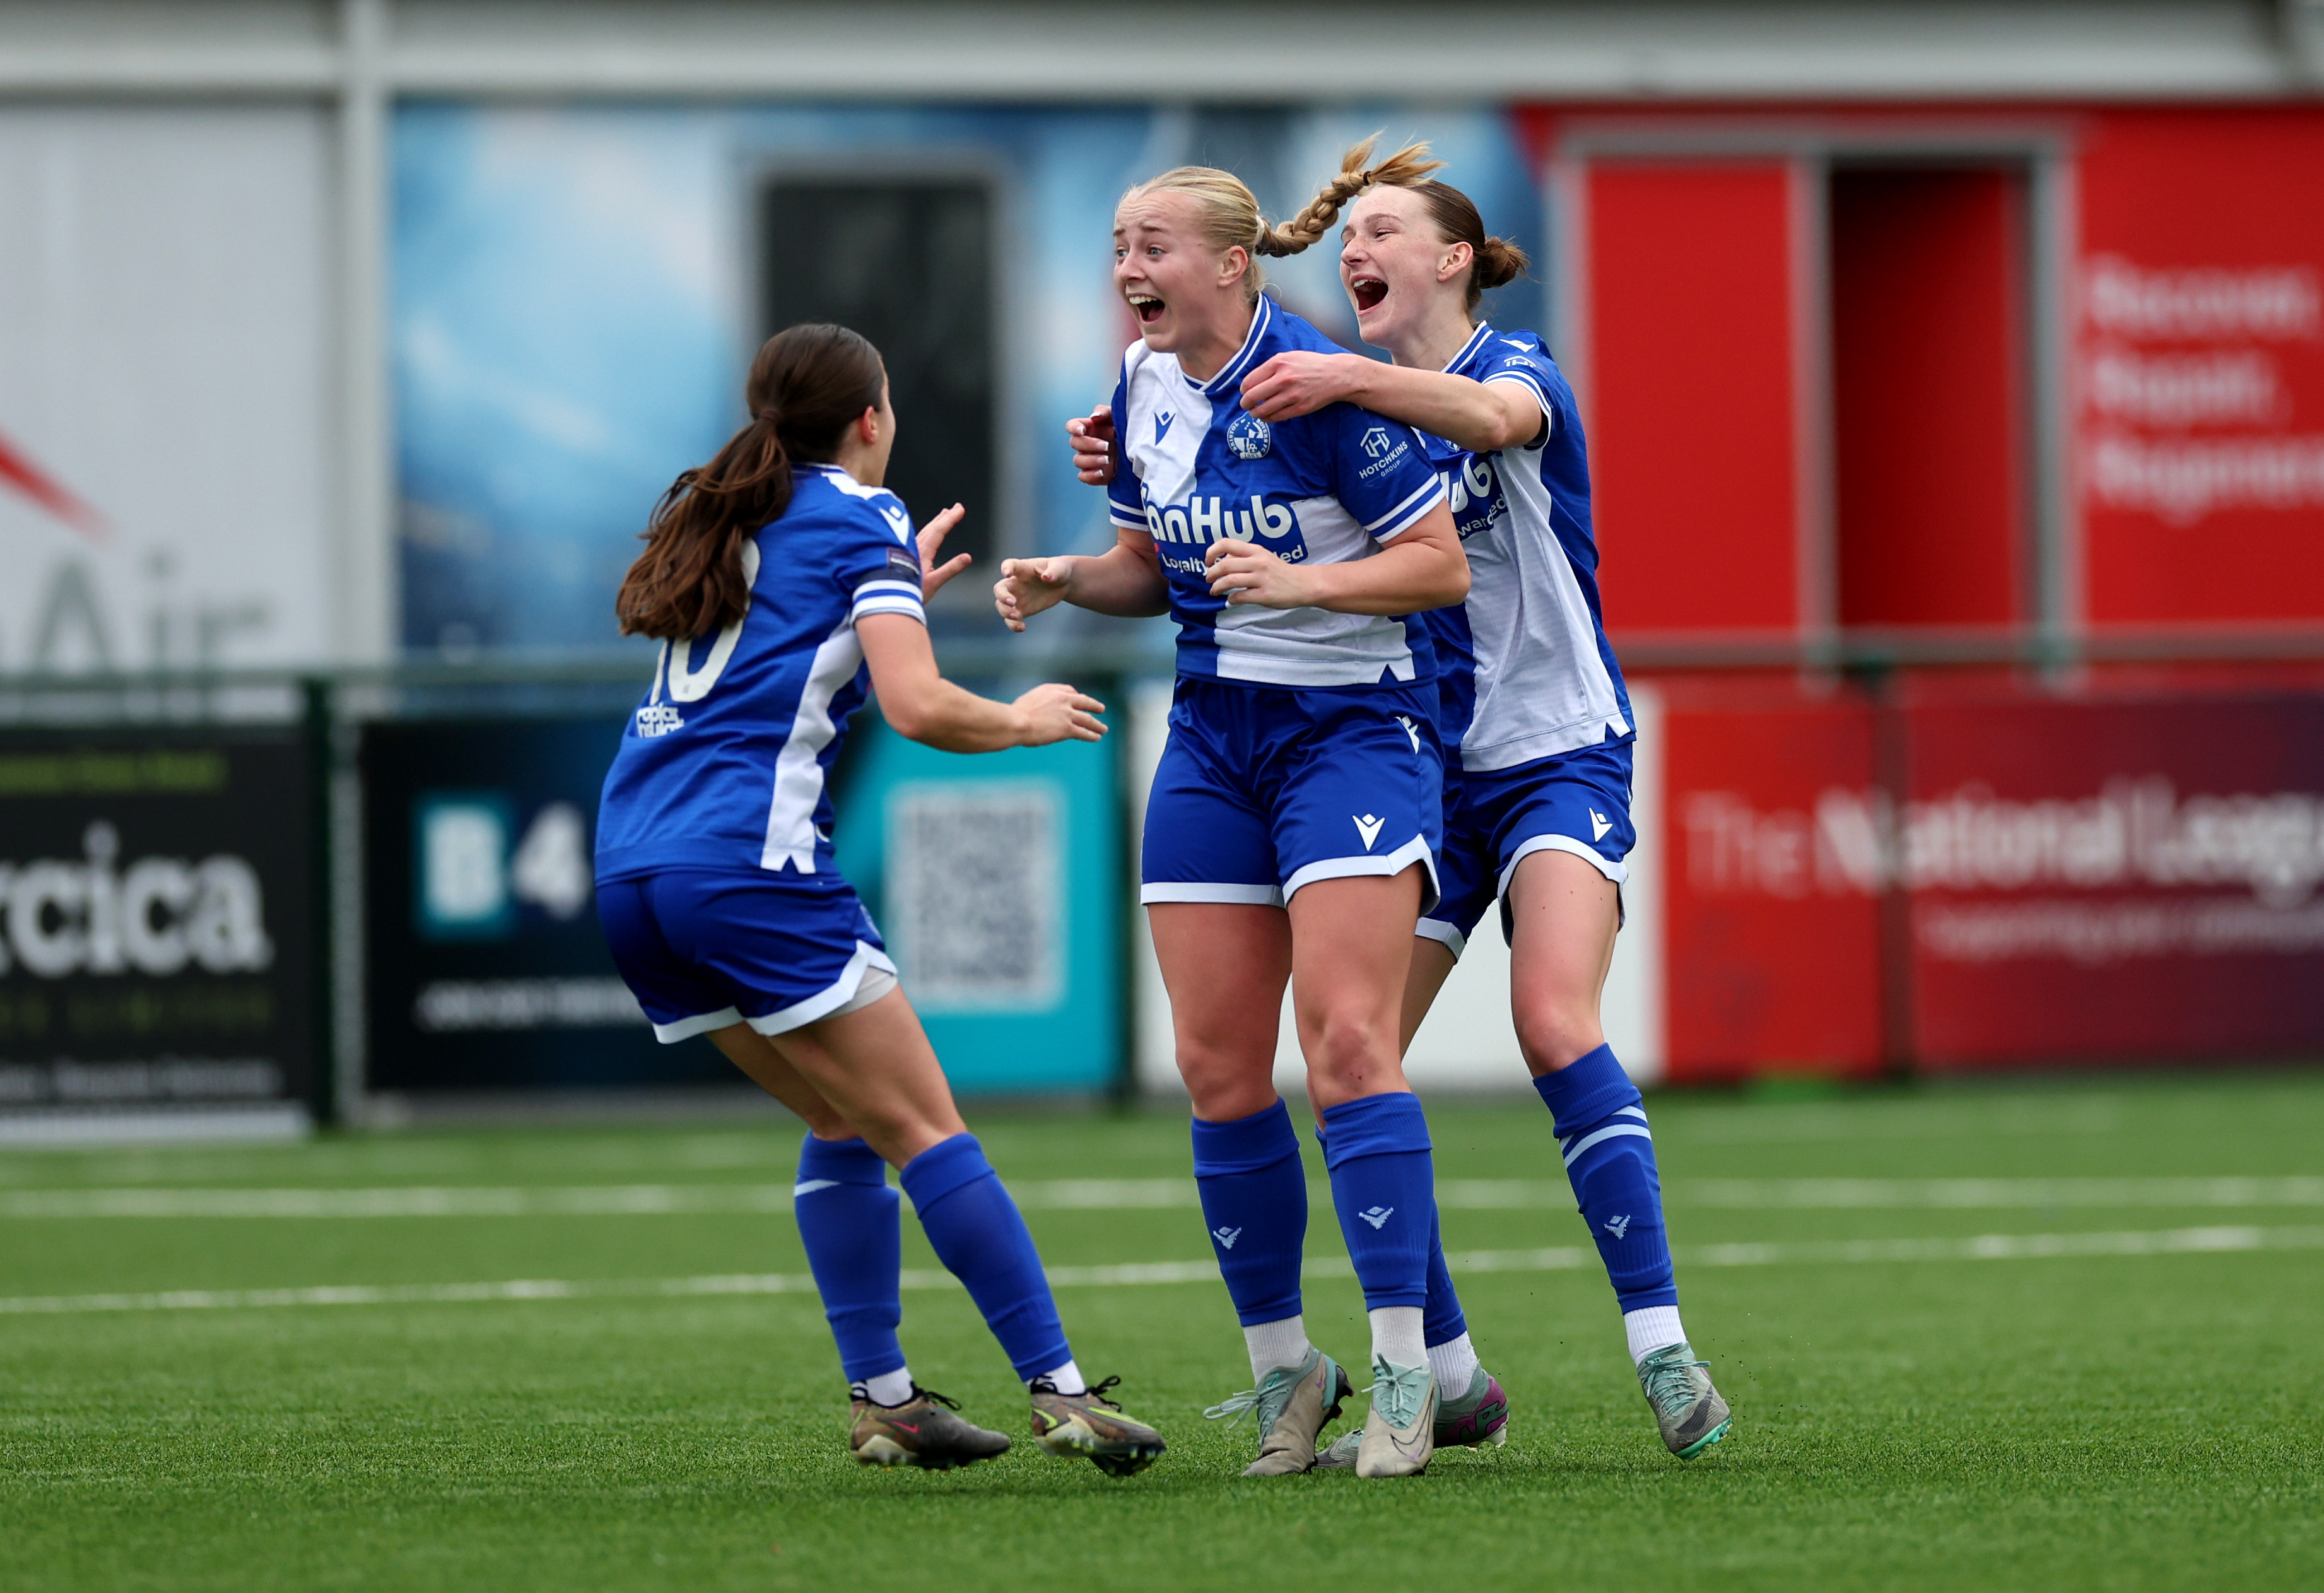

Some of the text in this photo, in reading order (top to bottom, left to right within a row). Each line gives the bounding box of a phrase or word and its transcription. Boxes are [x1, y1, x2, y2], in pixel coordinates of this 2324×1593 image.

[1229, 423, 1239, 451] BRISTOL
[1256, 418, 1268, 452] ROVERS FC
[1359, 441, 1408, 479] HOTCHKINS
[1380, 460, 1400, 477] GROUP
[1457, 493, 1506, 536] warded
[1161, 553, 1208, 577] Loyalty
[0, 548, 273, 724] Air
[2132, 777, 2324, 907] Leag
